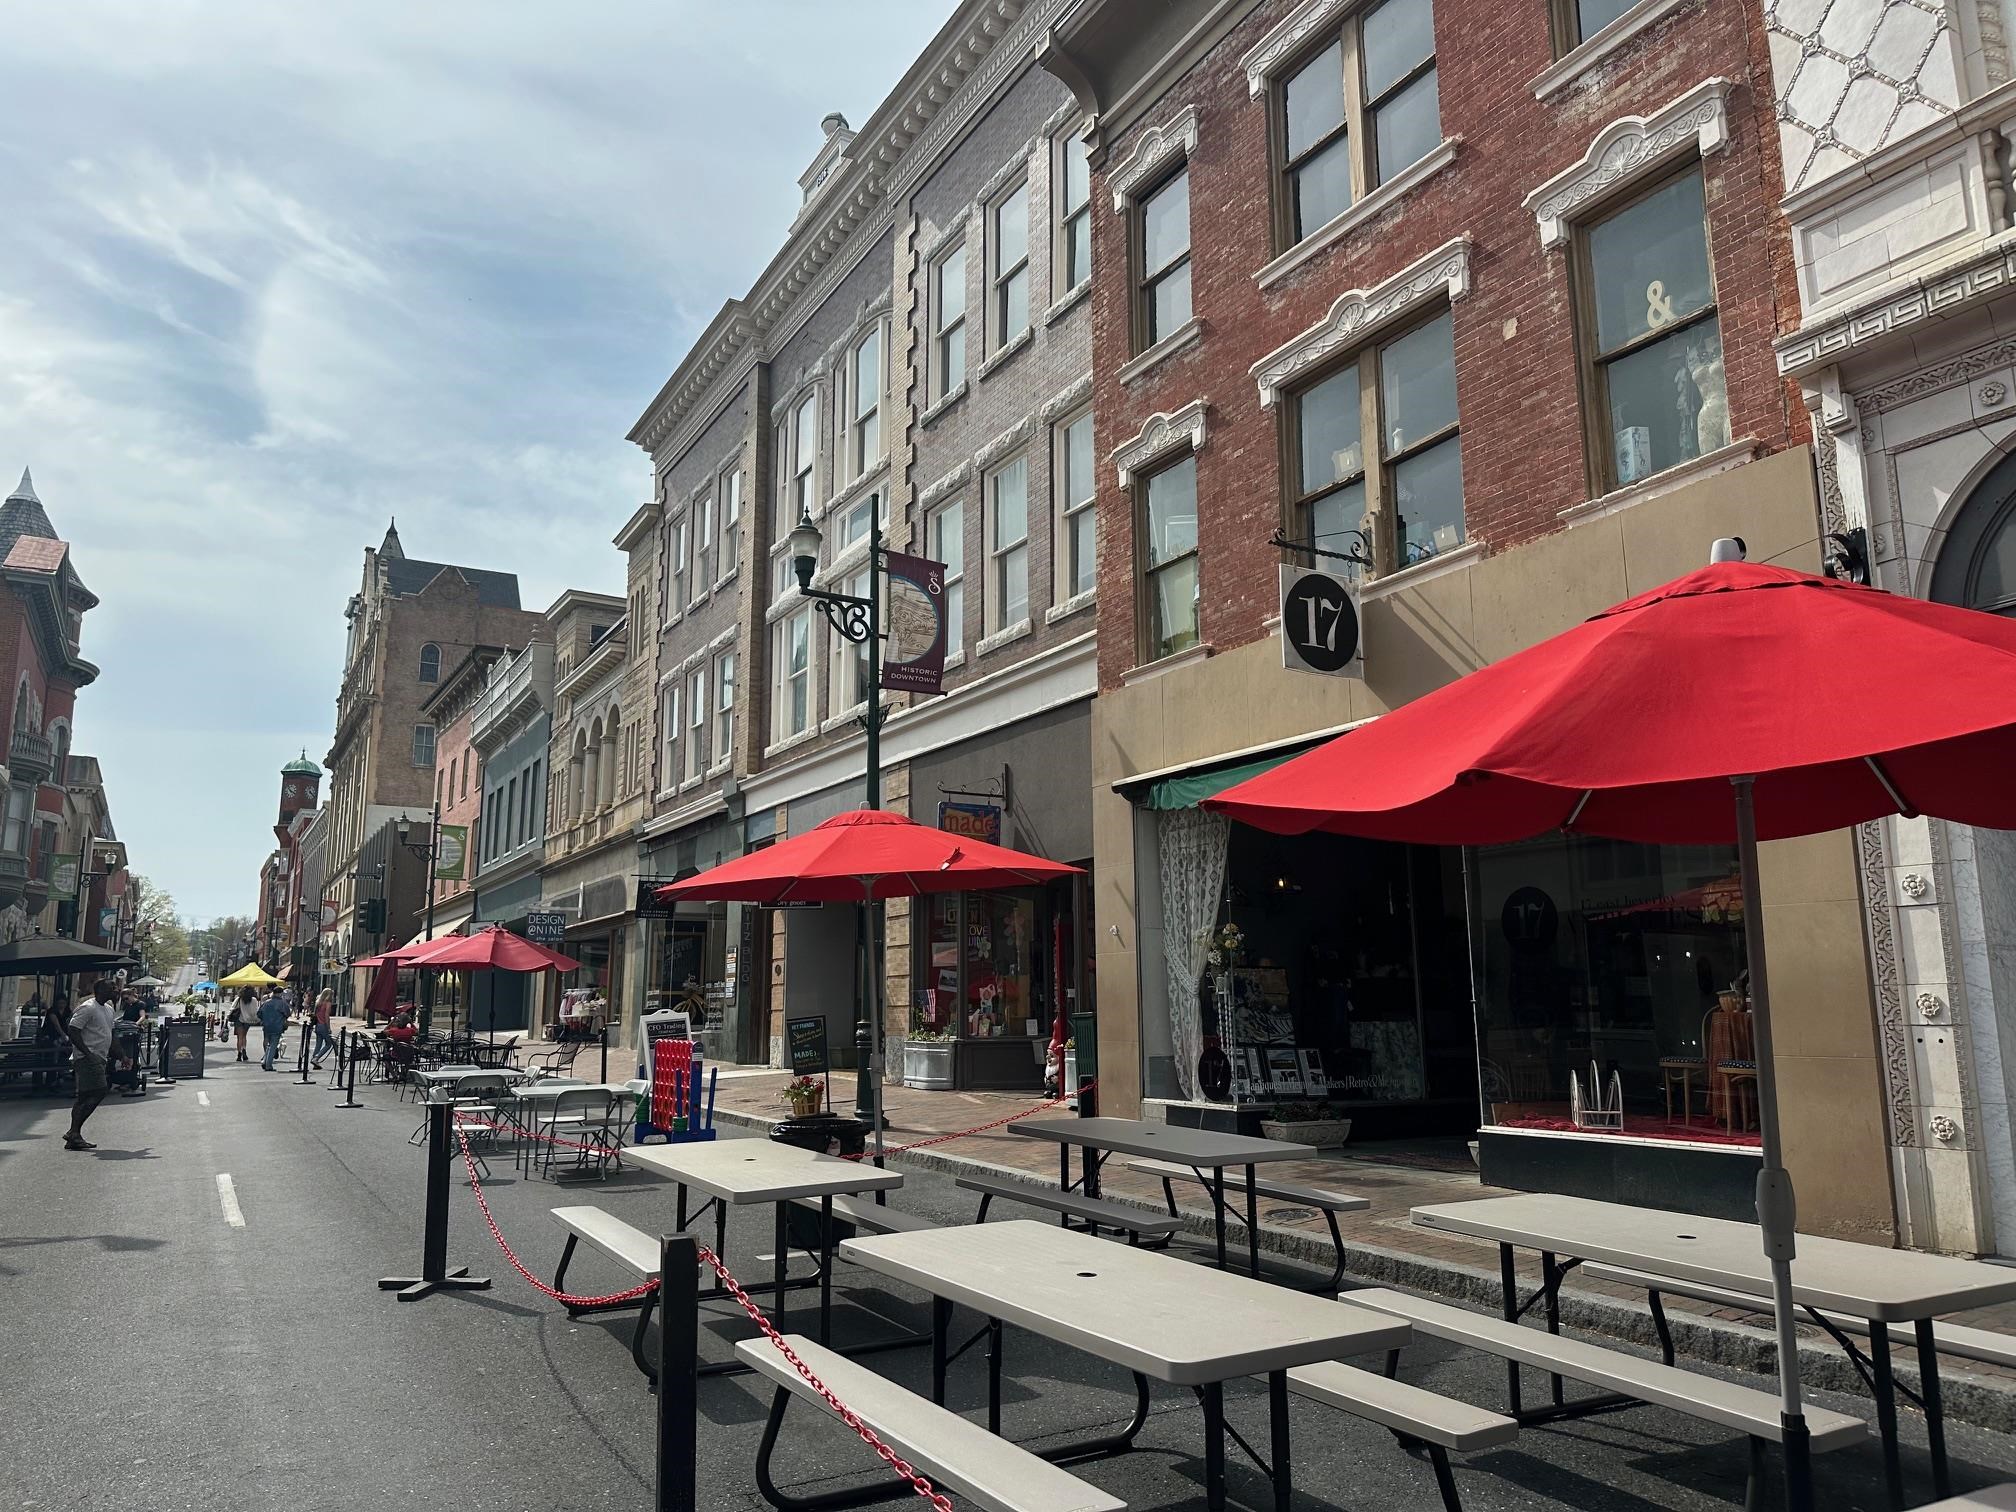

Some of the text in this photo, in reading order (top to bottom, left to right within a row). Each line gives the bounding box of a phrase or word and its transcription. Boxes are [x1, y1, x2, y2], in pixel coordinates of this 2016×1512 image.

[1647, 280, 1678, 329] &
[1298, 596, 1343, 652] 17
[891, 672, 937, 684] DOWNTOWN
[901, 666, 938, 676] HISTORIC
[944, 810, 996, 833] made
[528, 915, 565, 924] DESIGN
[1511, 901, 1545, 940] 17
[528, 925, 564, 935] @NINE
